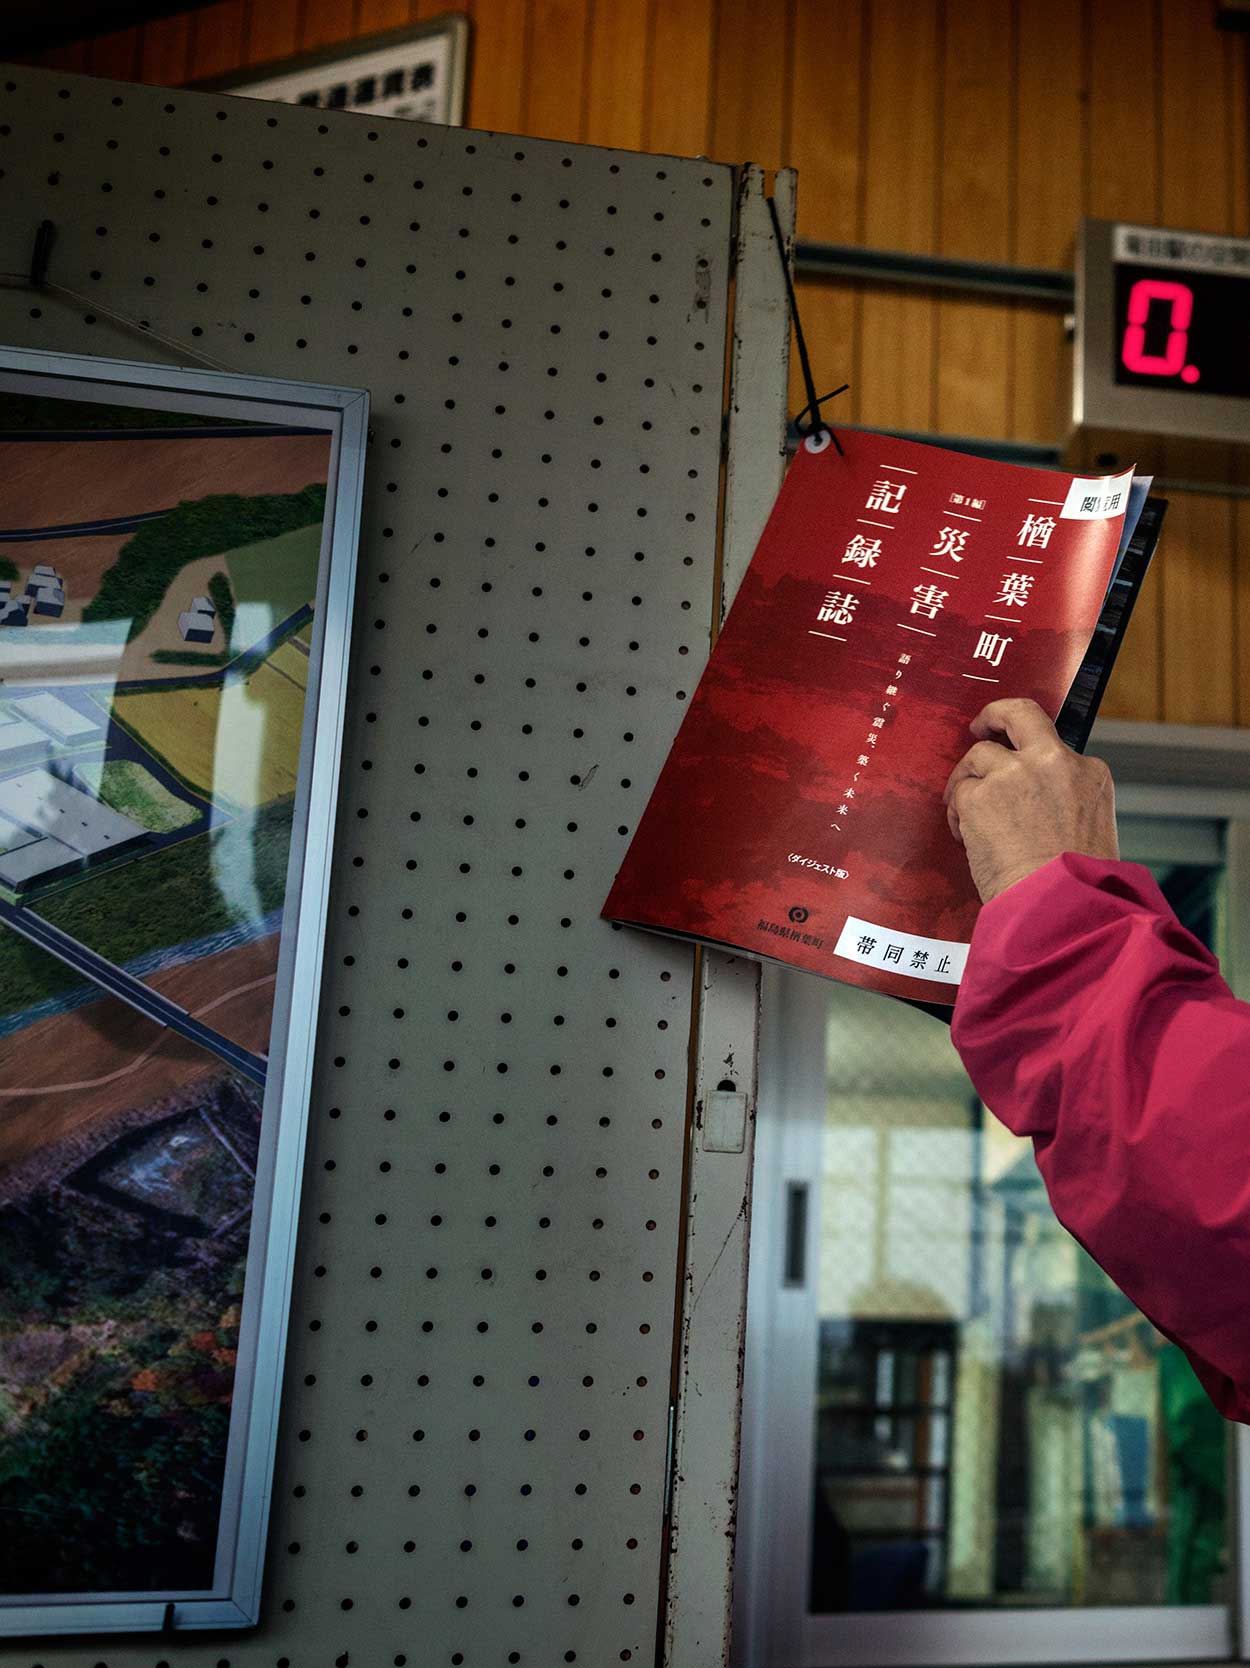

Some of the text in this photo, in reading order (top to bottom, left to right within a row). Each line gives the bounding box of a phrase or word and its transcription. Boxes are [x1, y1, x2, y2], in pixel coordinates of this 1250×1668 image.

[816, 480, 908, 626] 記録誌
[909, 526, 971, 620] 災害
[973, 514, 1057, 667] 楢葉町
[857, 935, 952, 974] 帯同禁止
